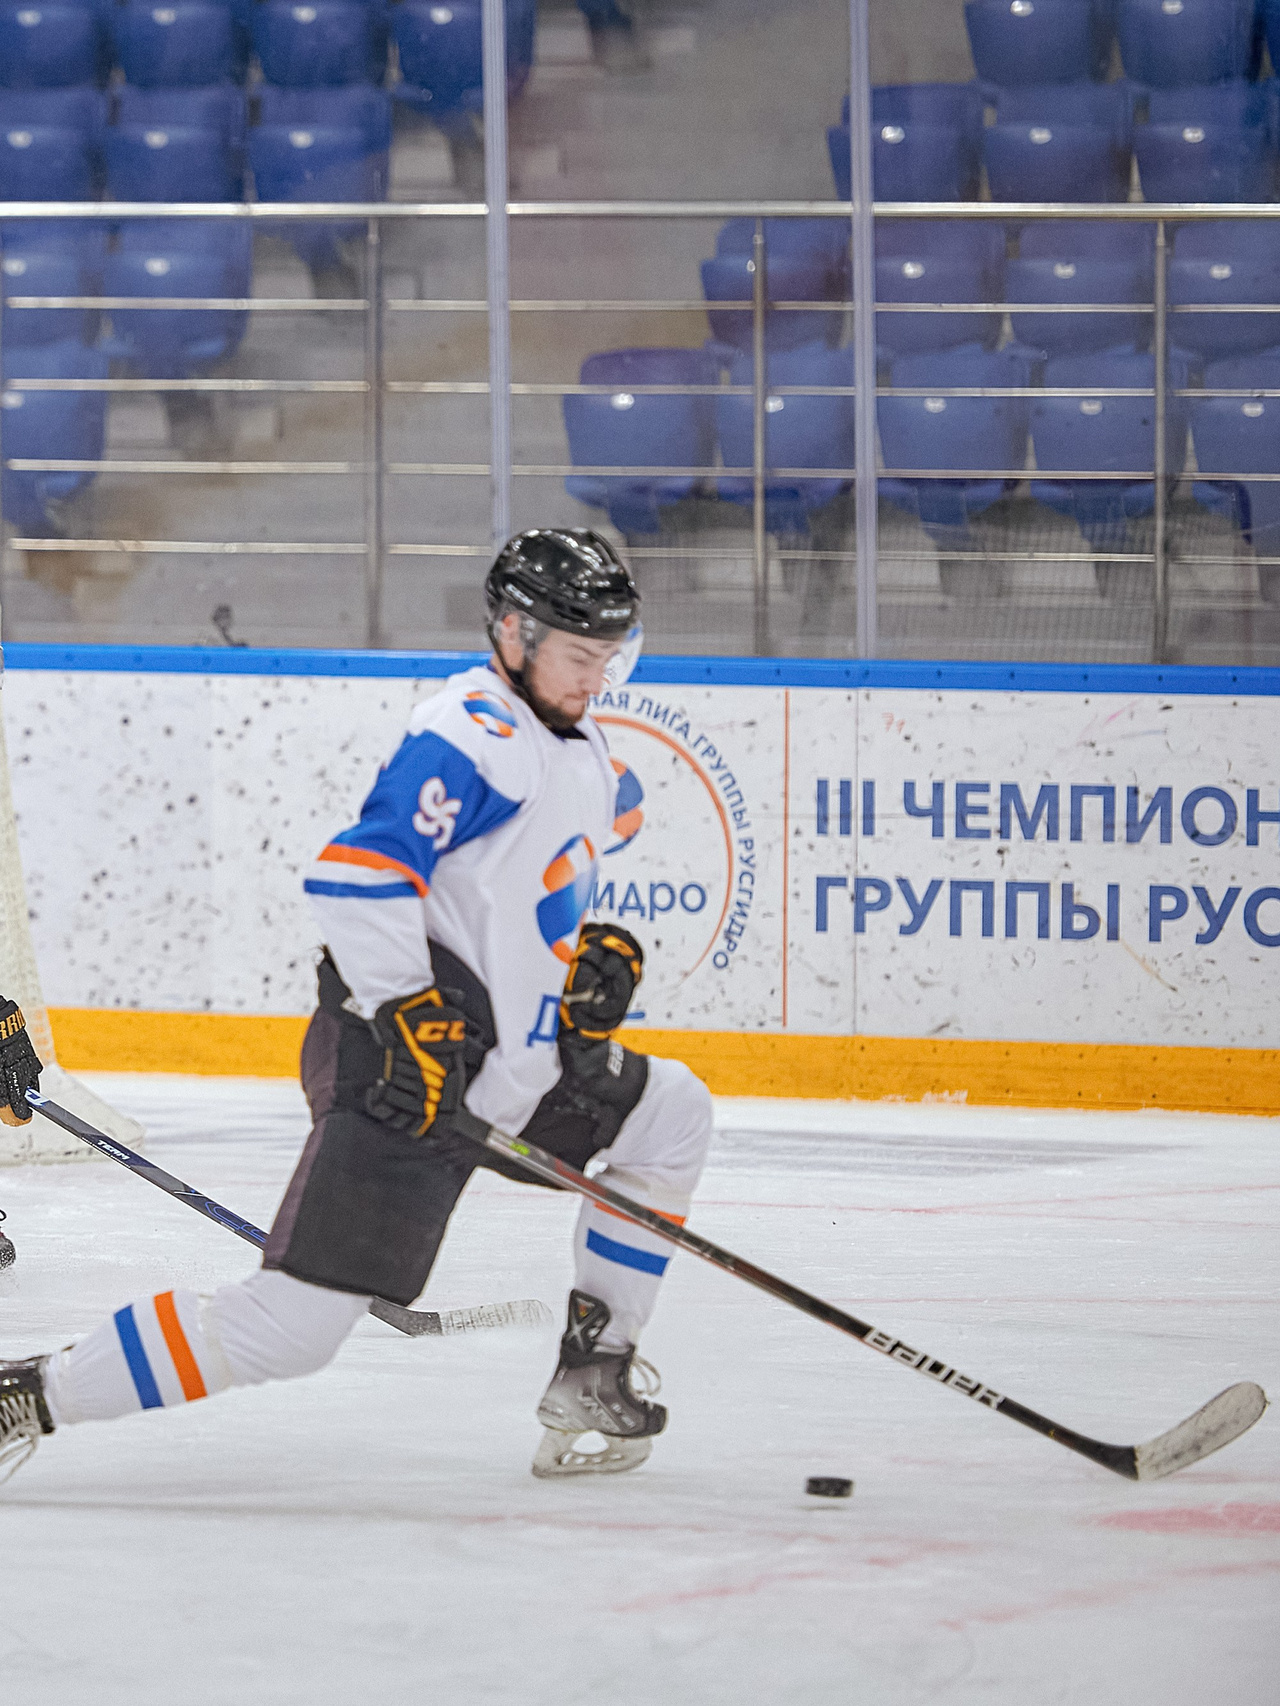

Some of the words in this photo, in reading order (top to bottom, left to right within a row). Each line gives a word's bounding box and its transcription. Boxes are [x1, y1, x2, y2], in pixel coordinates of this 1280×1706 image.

[636, 698, 692, 741] ЛИГА
[693, 733, 752, 830] ГРУППЫ
[712, 836, 756, 970] РУСГИДРО
[815, 875, 1120, 943] ГРУППЫ
[98, 1139, 131, 1161] TEAM
[863, 1326, 1006, 1410] BAUER
